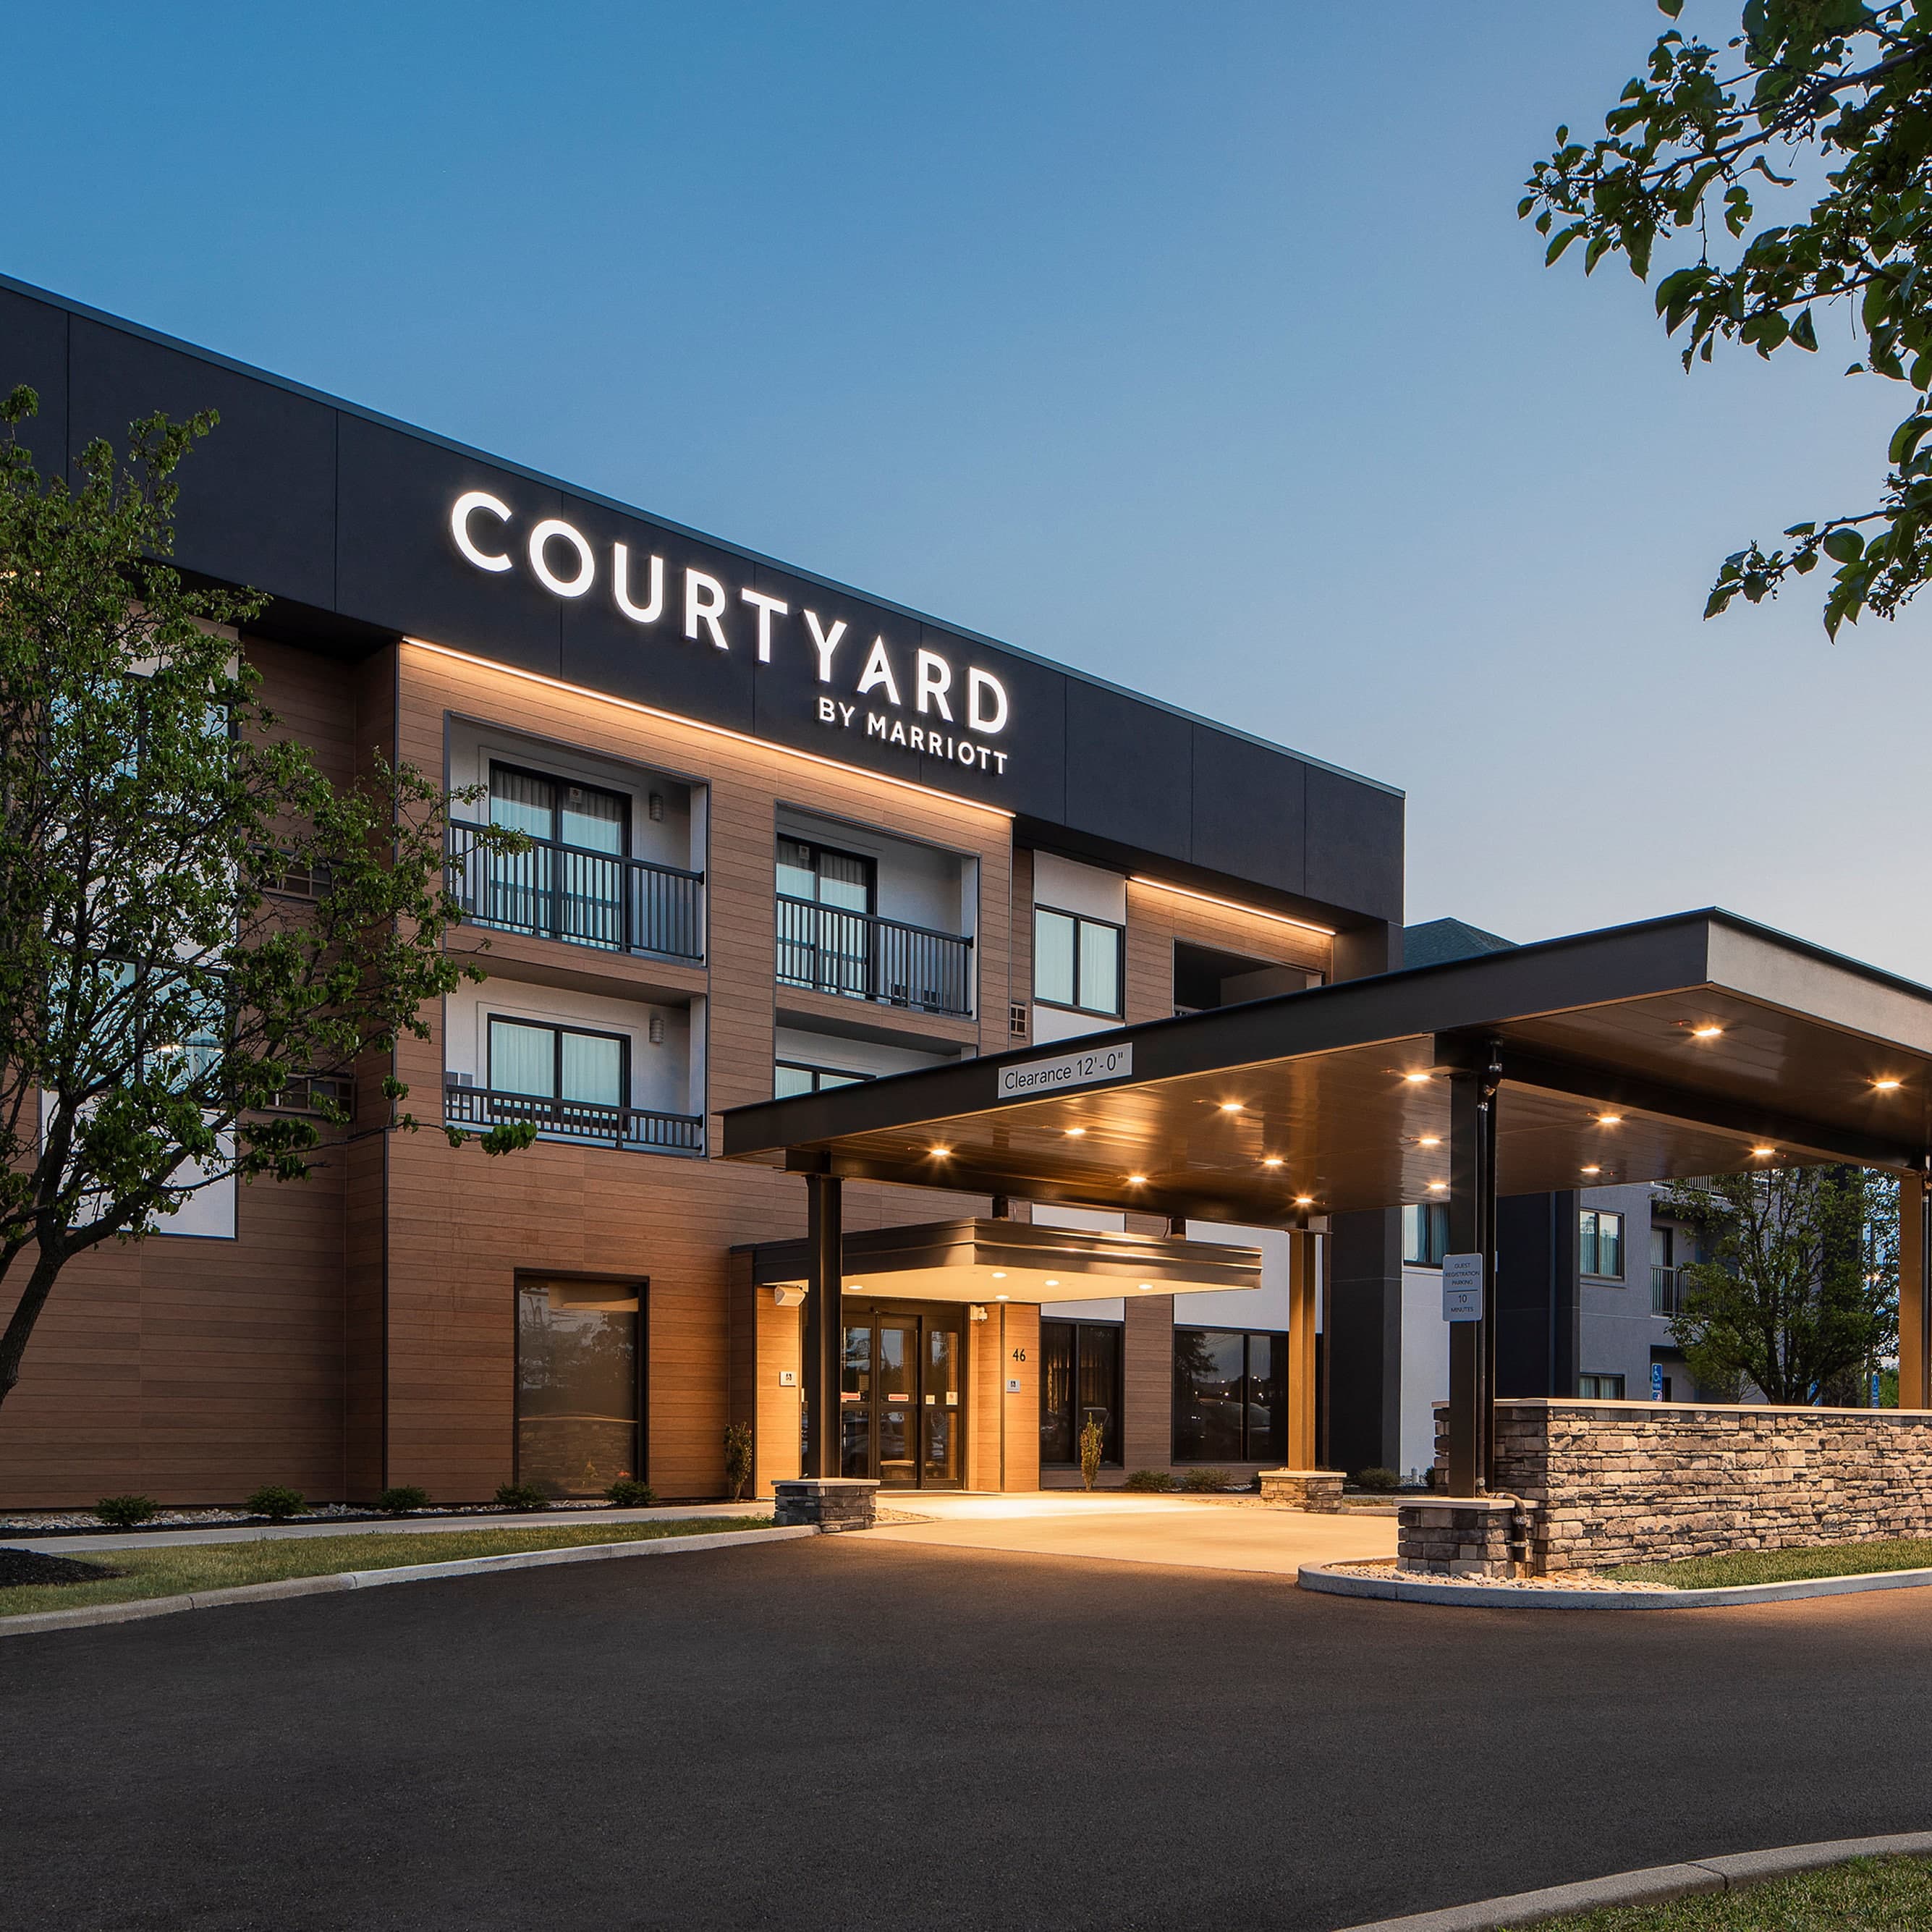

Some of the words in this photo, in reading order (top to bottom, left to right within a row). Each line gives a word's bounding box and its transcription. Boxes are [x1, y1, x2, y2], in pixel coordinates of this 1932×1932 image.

[450, 491, 1009, 734] COURTYARD
[818, 698, 856, 727] BY
[867, 712, 1008, 774] MARRIOTT
[1004, 1066, 1072, 1090] Clearance
[1458, 1294, 1467, 1303] 10
[1012, 1348, 1026, 1363] 46
